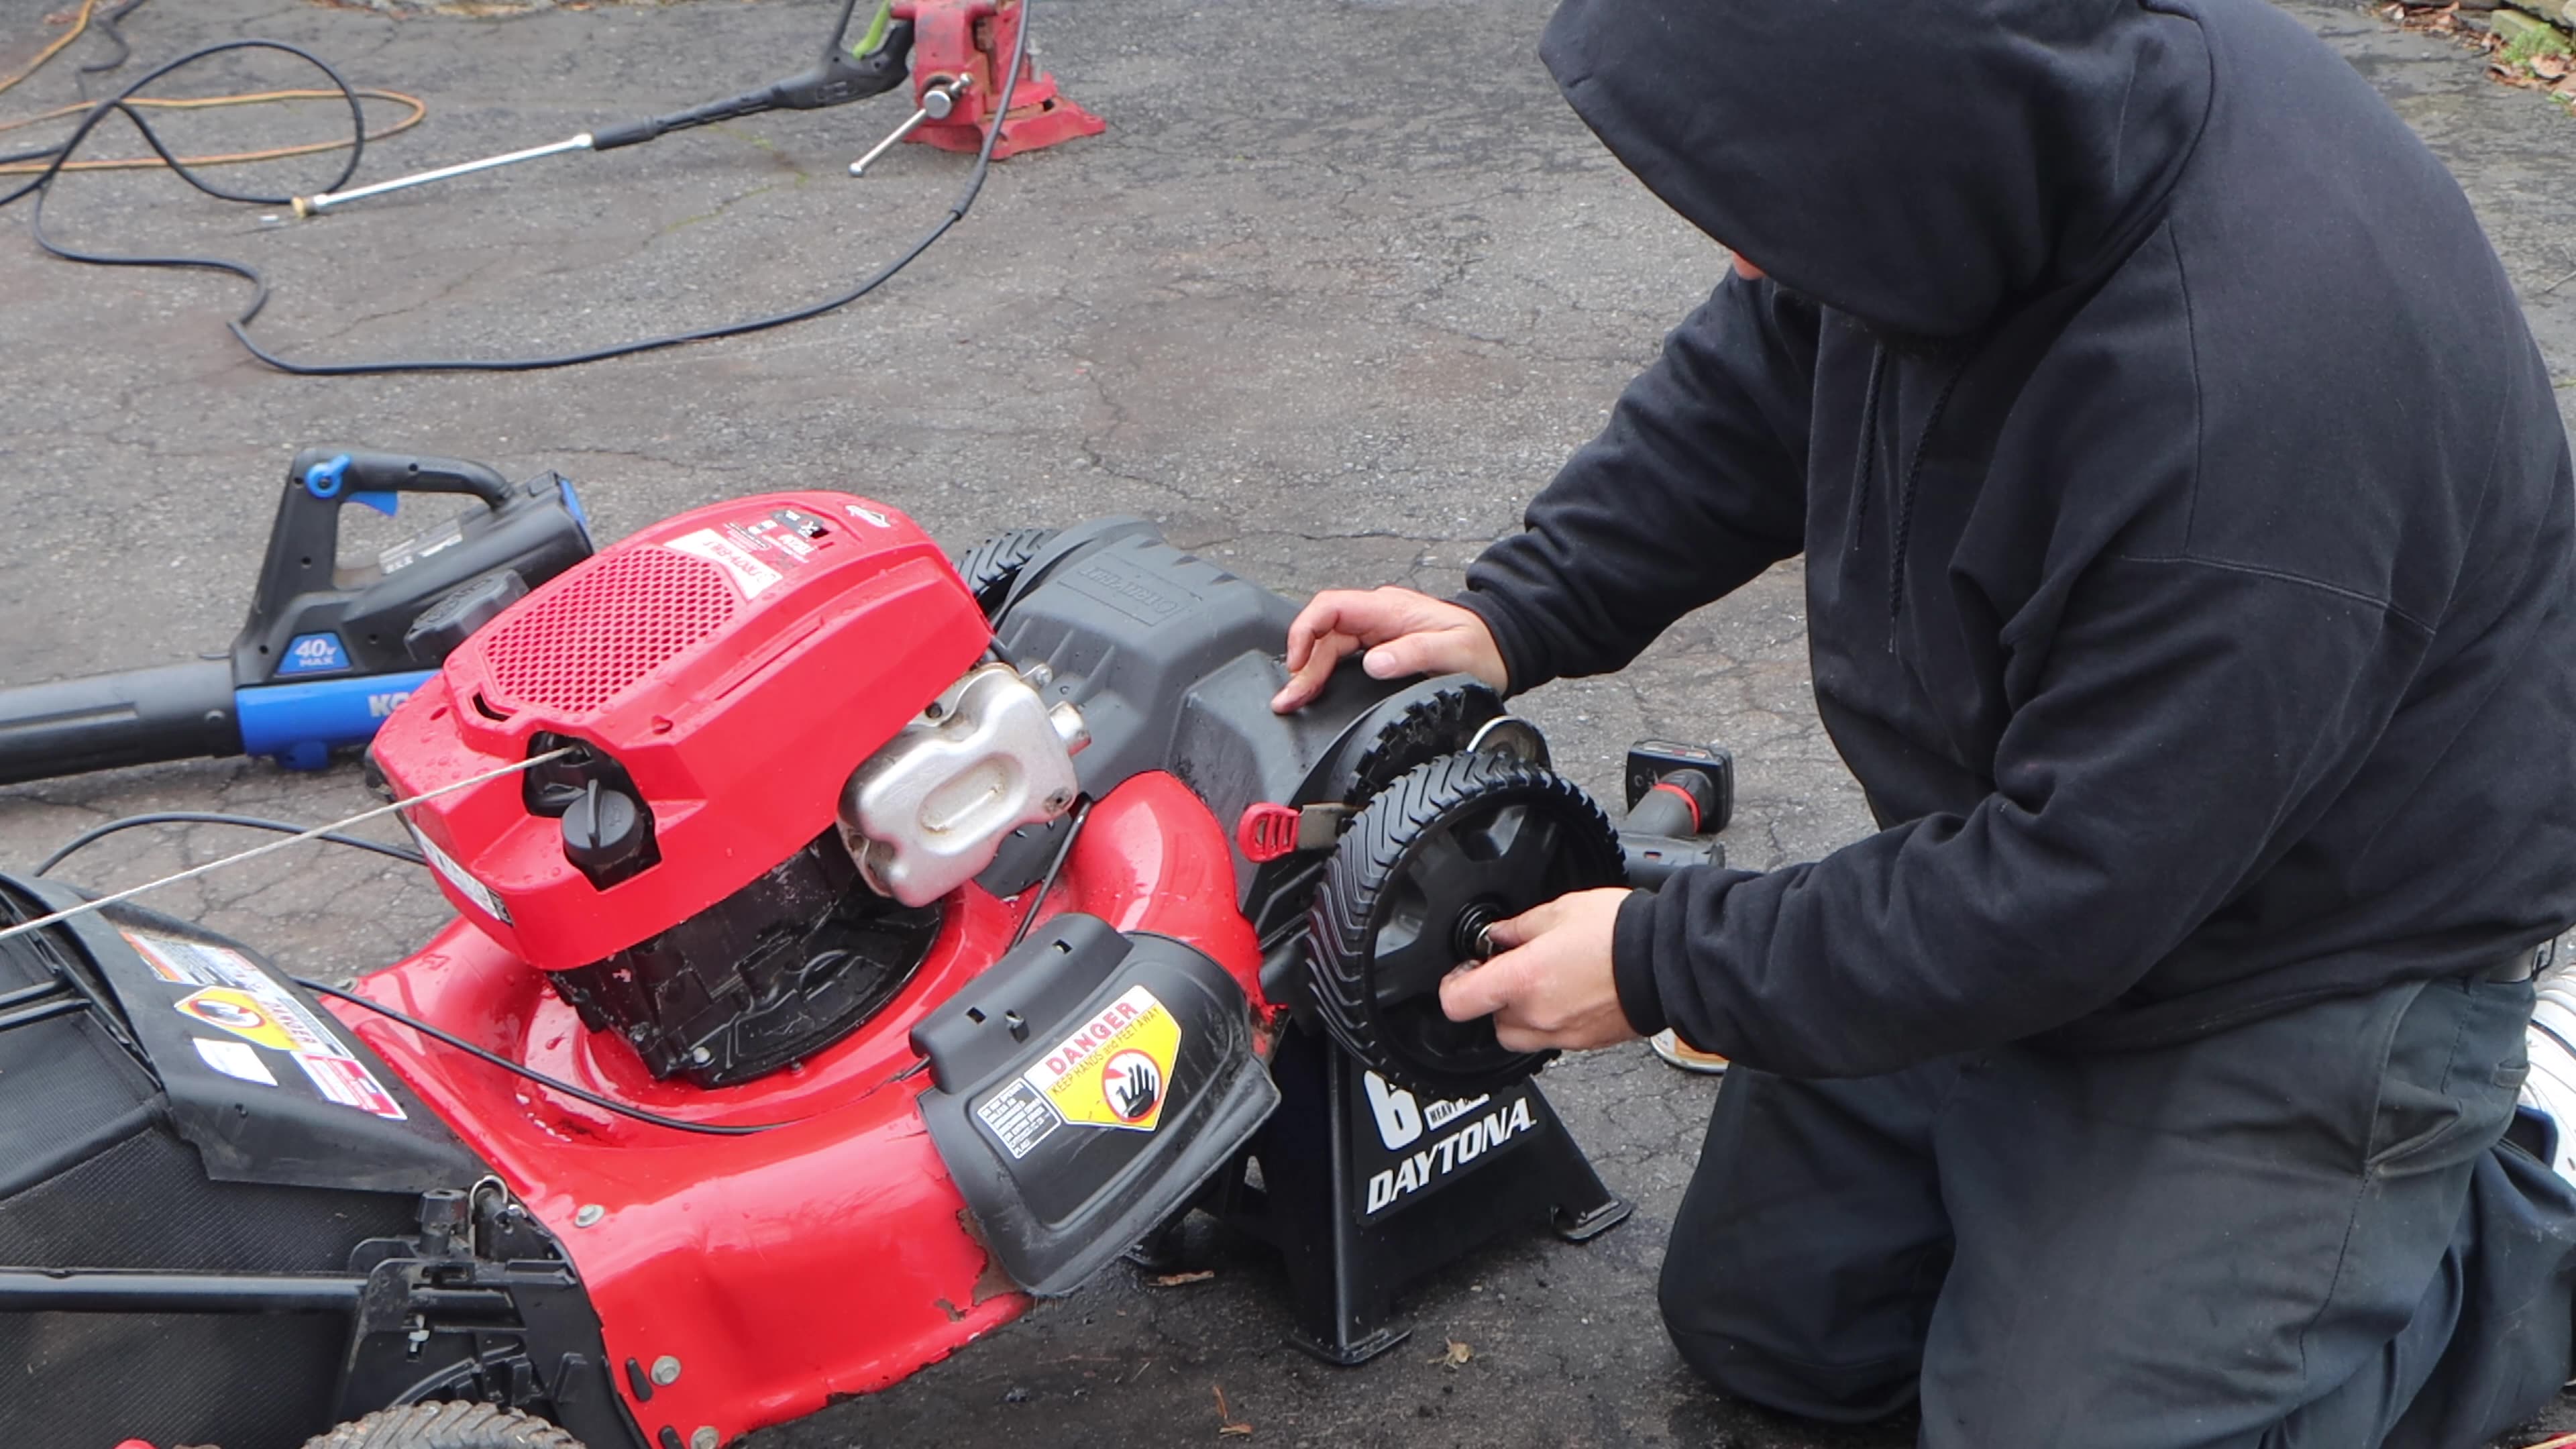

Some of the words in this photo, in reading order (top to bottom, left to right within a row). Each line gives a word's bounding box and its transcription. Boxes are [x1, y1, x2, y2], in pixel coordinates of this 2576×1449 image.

[299, 657, 333, 667] MAX
[1045, 1002, 1138, 1075] DANGER
[1051, 1075, 1073, 1096] KEEP
[1075, 1053, 1104, 1077] HANDS
[1102, 1039, 1118, 1054] and
[1116, 1026, 1138, 1044] FEET
[1136, 1008, 1159, 1028] AWAY
[1366, 1097, 1531, 1215] DAYTONA
